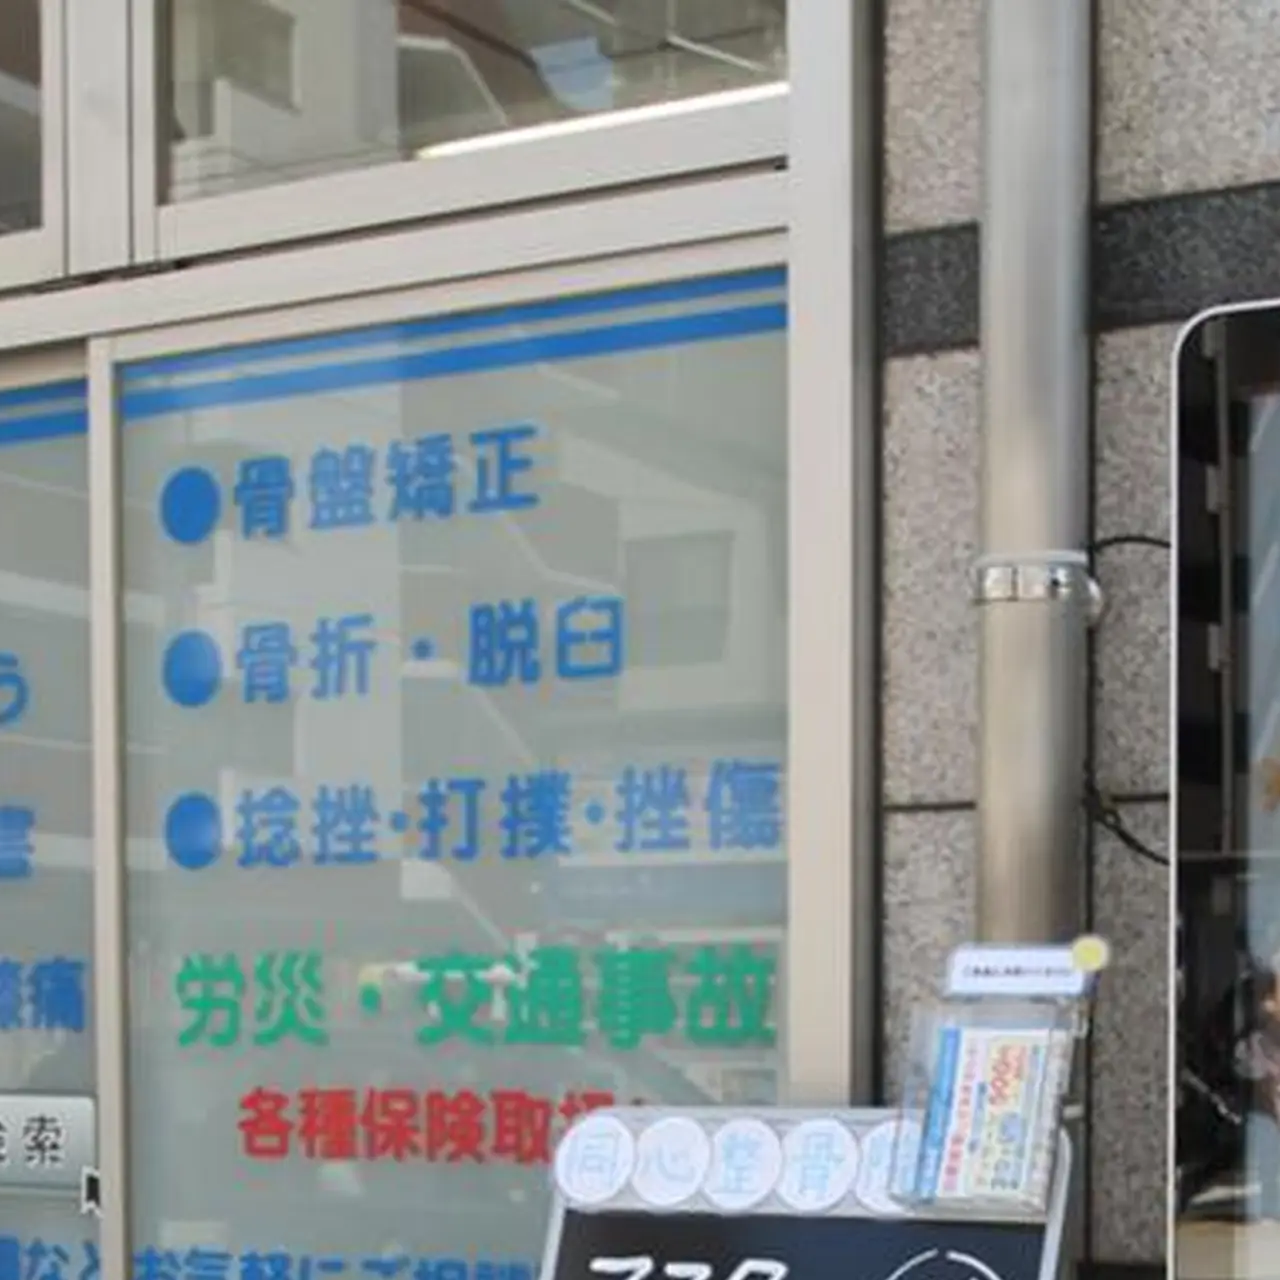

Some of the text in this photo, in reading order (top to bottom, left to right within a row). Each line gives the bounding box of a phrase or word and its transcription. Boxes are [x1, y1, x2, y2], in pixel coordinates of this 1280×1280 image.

[234, 425, 539, 540] 骨盤矯正
[236, 596, 624, 703] 骨折・脱臼
[174, 945, 777, 1050] 労災・交通事故
